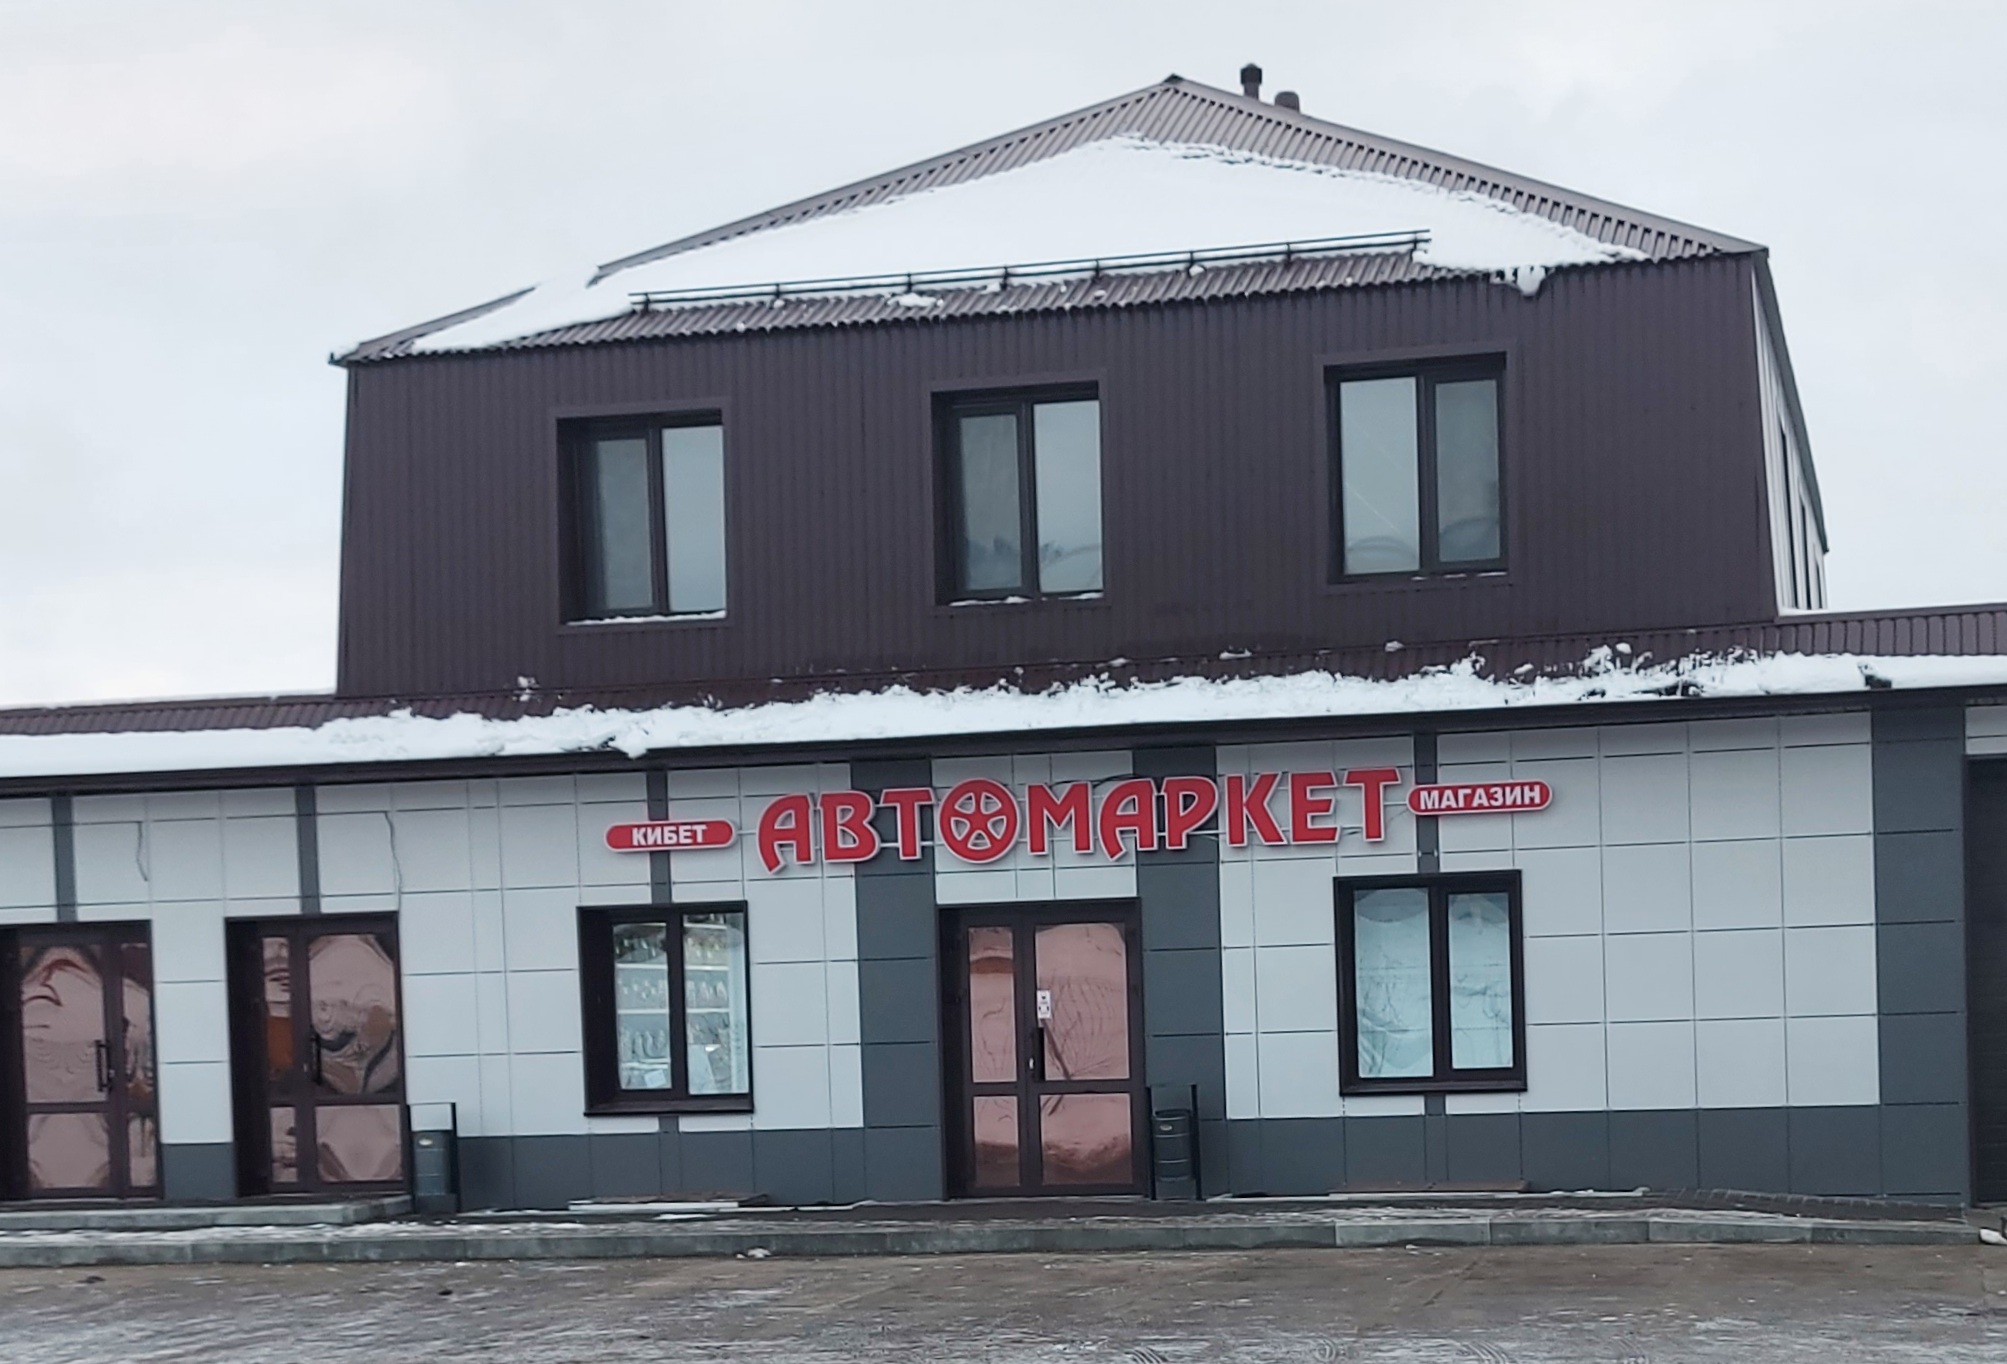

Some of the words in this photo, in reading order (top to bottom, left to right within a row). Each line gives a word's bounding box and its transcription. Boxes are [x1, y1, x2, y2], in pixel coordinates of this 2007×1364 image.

[1419, 784, 1541, 811] МАГАЗИН
[757, 767, 1401, 874] АВТОМАРКЕТ
[631, 824, 707, 847] КИБЕТ
